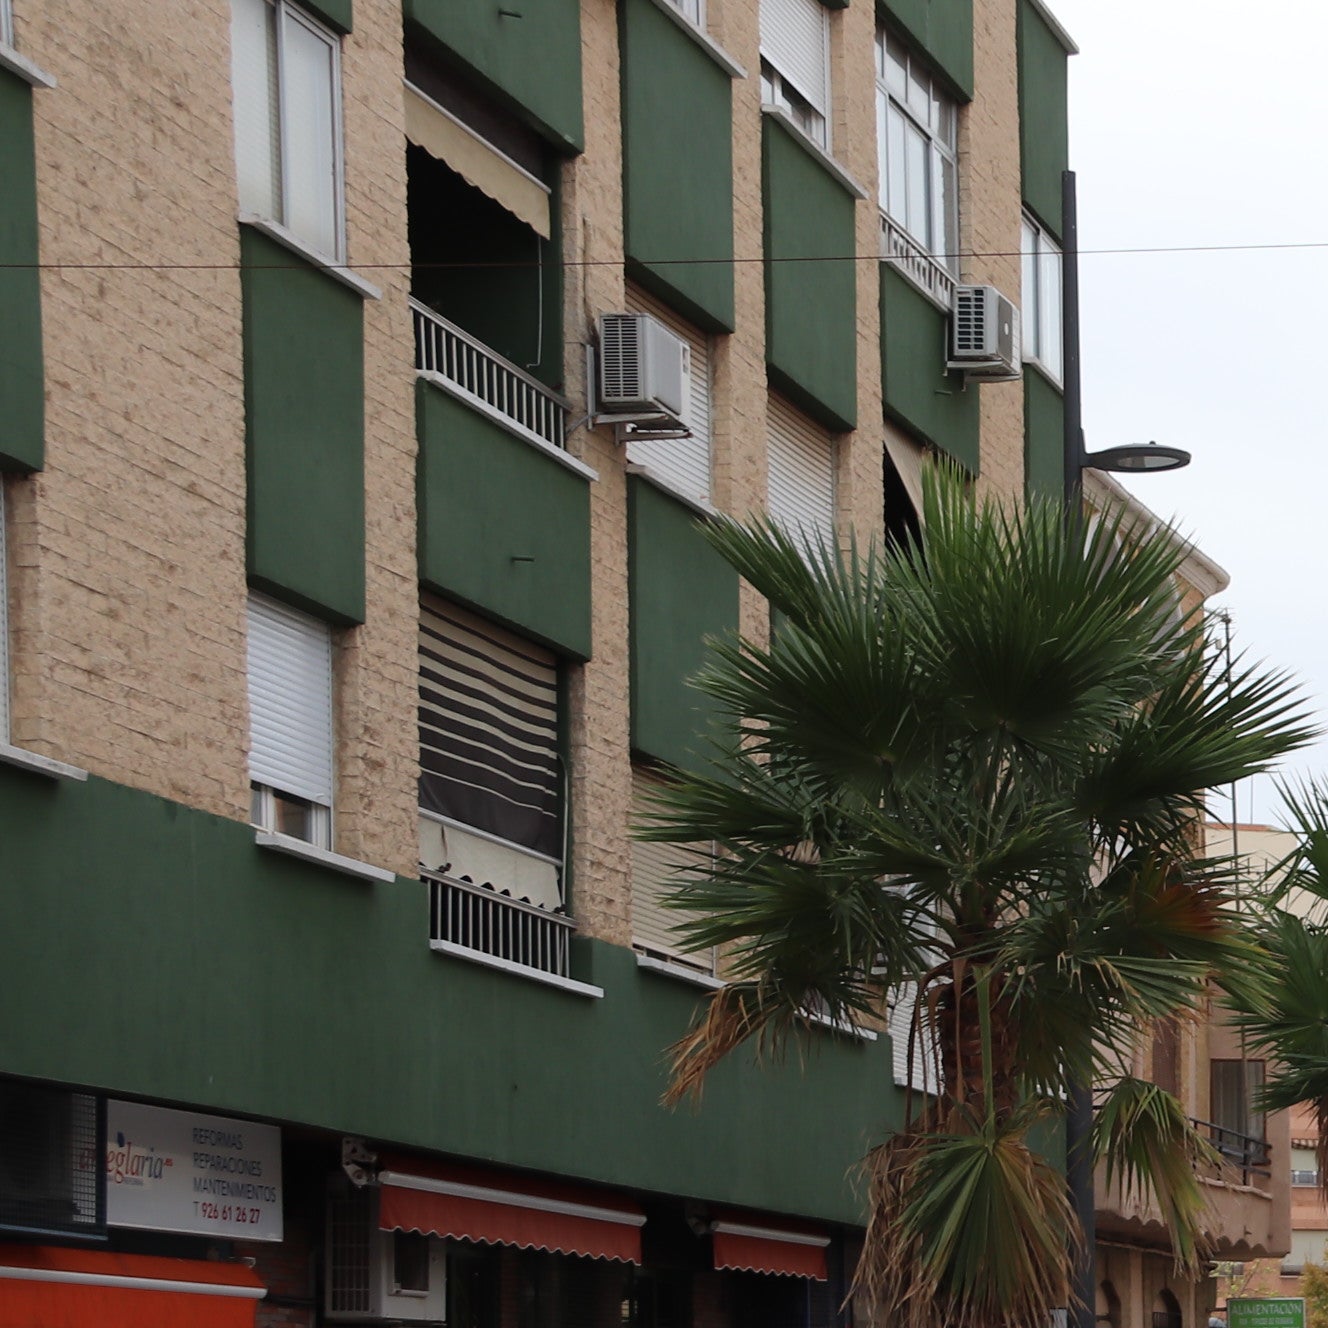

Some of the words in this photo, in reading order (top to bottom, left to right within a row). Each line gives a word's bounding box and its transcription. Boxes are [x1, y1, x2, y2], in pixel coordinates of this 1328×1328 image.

[192, 1127, 244, 1150] REFORMAS
[192, 1152, 263, 1177] REPARACIONES
[192, 1177, 277, 1203] MANTENIMIENTOS
[202, 1202, 219, 1220] 926
[222, 1203, 233, 1221] 61
[235, 1204, 247, 1222] 26
[249, 1207, 260, 1224] 27
